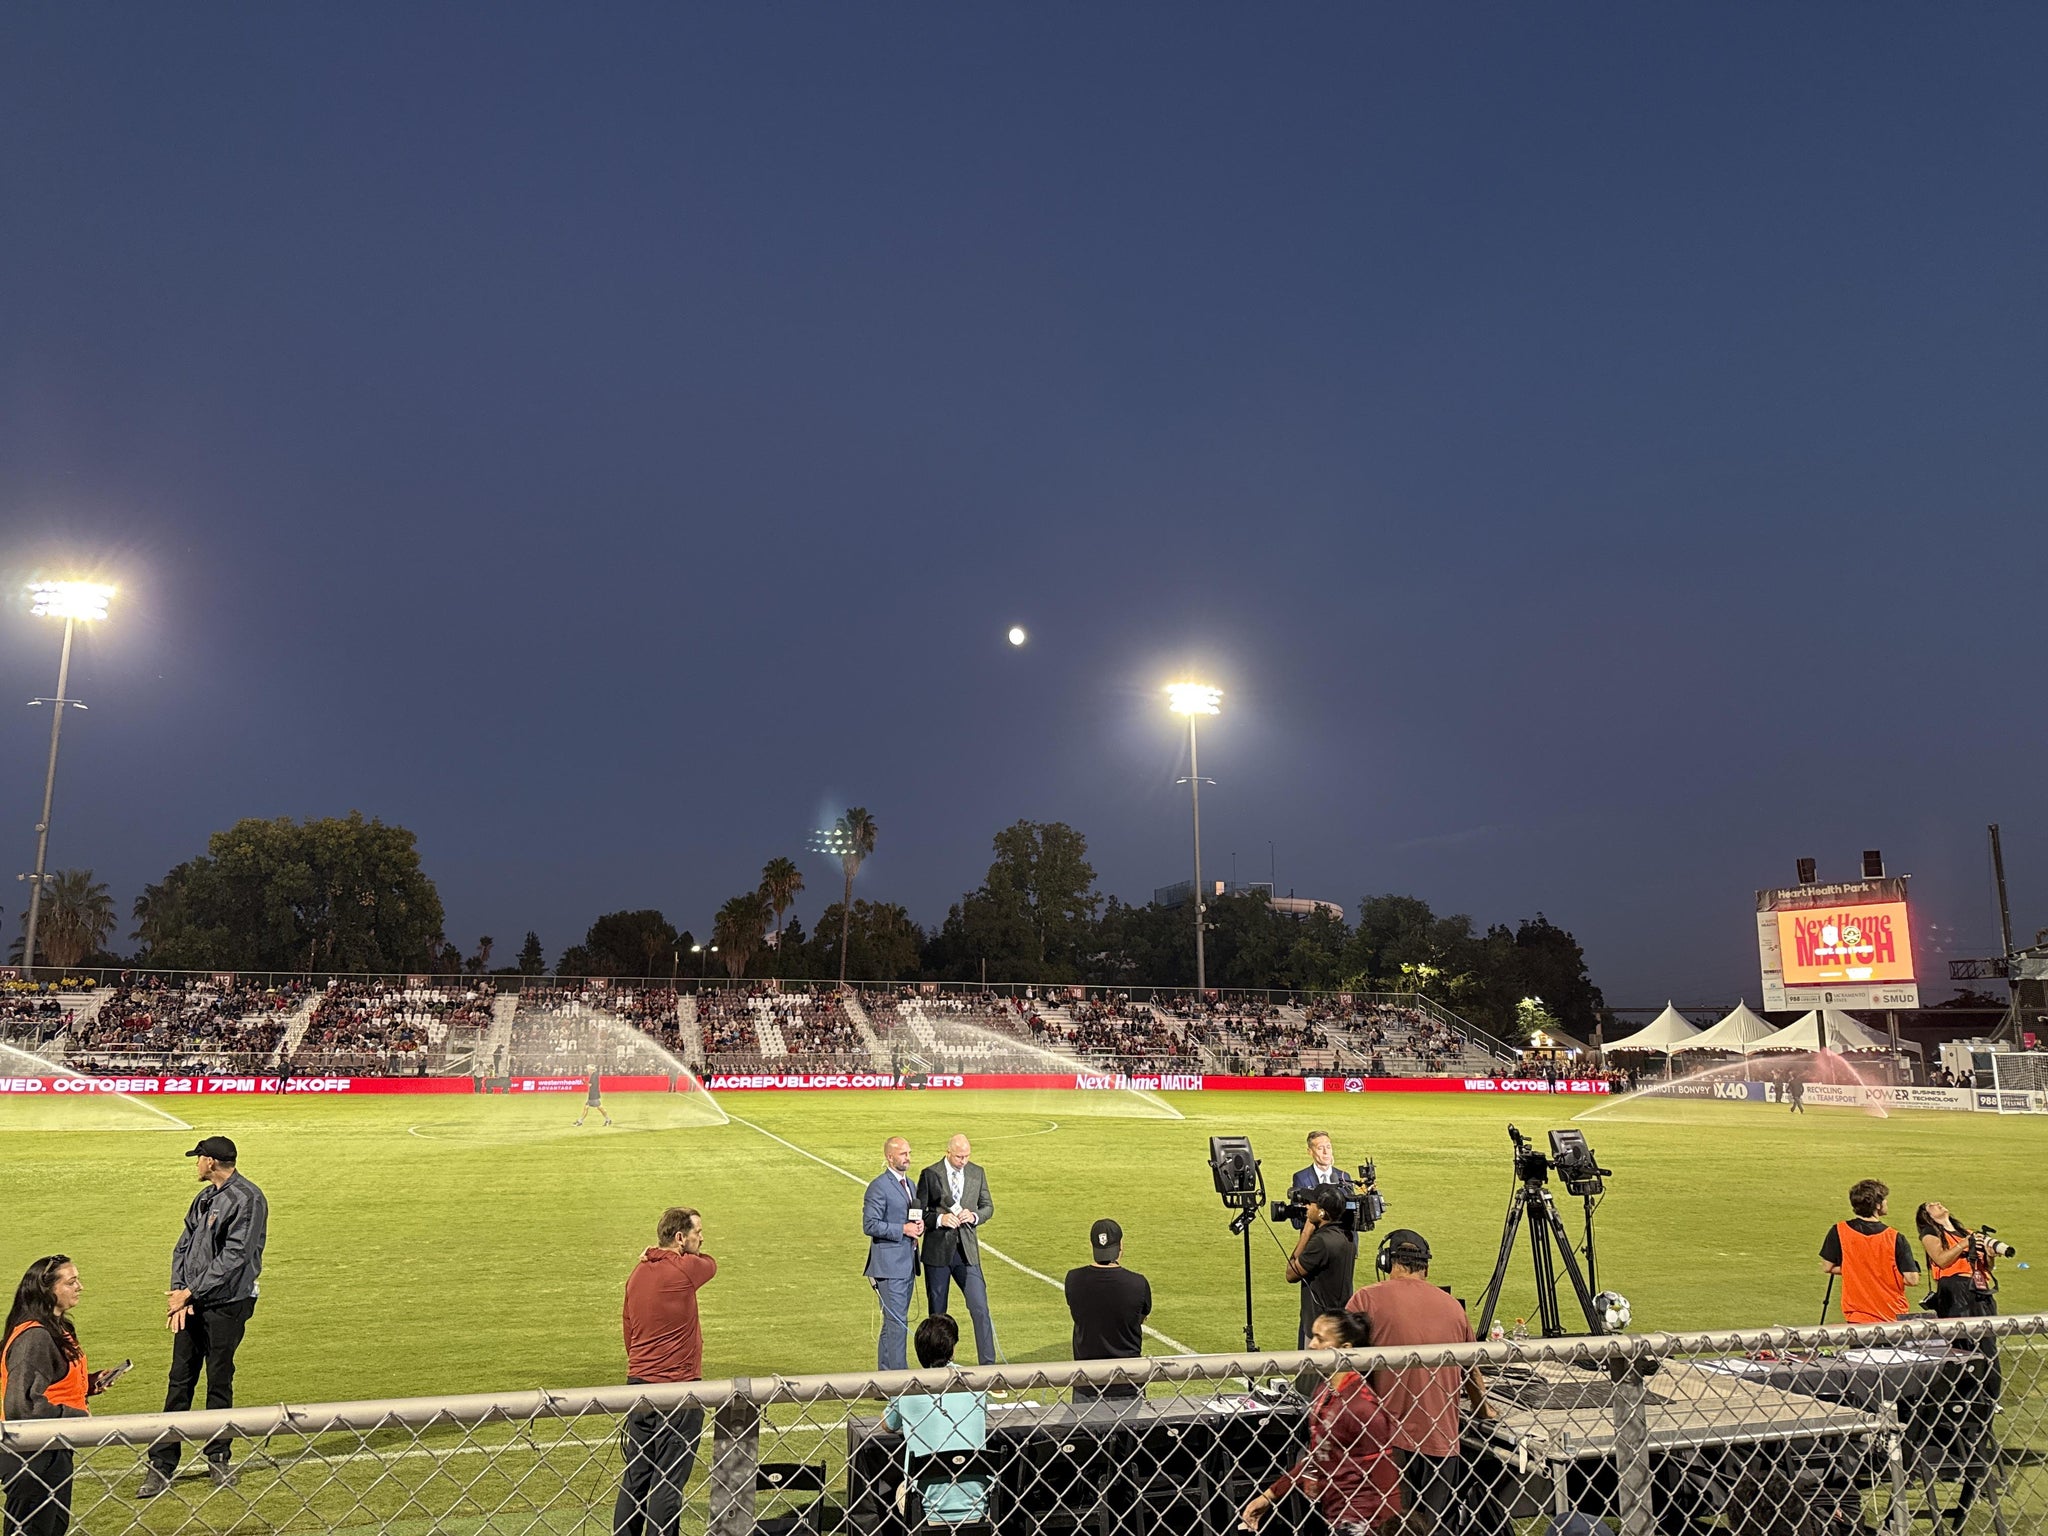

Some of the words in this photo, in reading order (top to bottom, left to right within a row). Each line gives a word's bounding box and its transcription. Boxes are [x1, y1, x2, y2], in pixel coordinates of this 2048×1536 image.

[1778, 889, 1807, 899] Heart
[1807, 885, 1843, 896] Health
[1842, 882, 1870, 893] Park
[1883, 994, 1915, 1003] SMUD
[53, 1078, 160, 1092] OCTOBER
[163, 1079, 193, 1092] 22
[208, 1080, 255, 1093] 7PM
[1075, 1073, 1111, 1090] Next
[1160, 1074, 1203, 1090] MATCH
[1464, 1079, 1499, 1091] WED.
[1500, 1080, 1568, 1092] OCTOBR
[1570, 1081, 1591, 1092] 22
[1636, 1083, 1676, 1094] MARRIOTT
[1806, 1086, 1843, 1095] RECYCLING
[1816, 1094, 1834, 1102] TEAM
[1834, 1095, 1857, 1103] SPORT
[1912, 1095, 1959, 1103] TECHNOLOGY
[1979, 1096, 1998, 1106] 988
